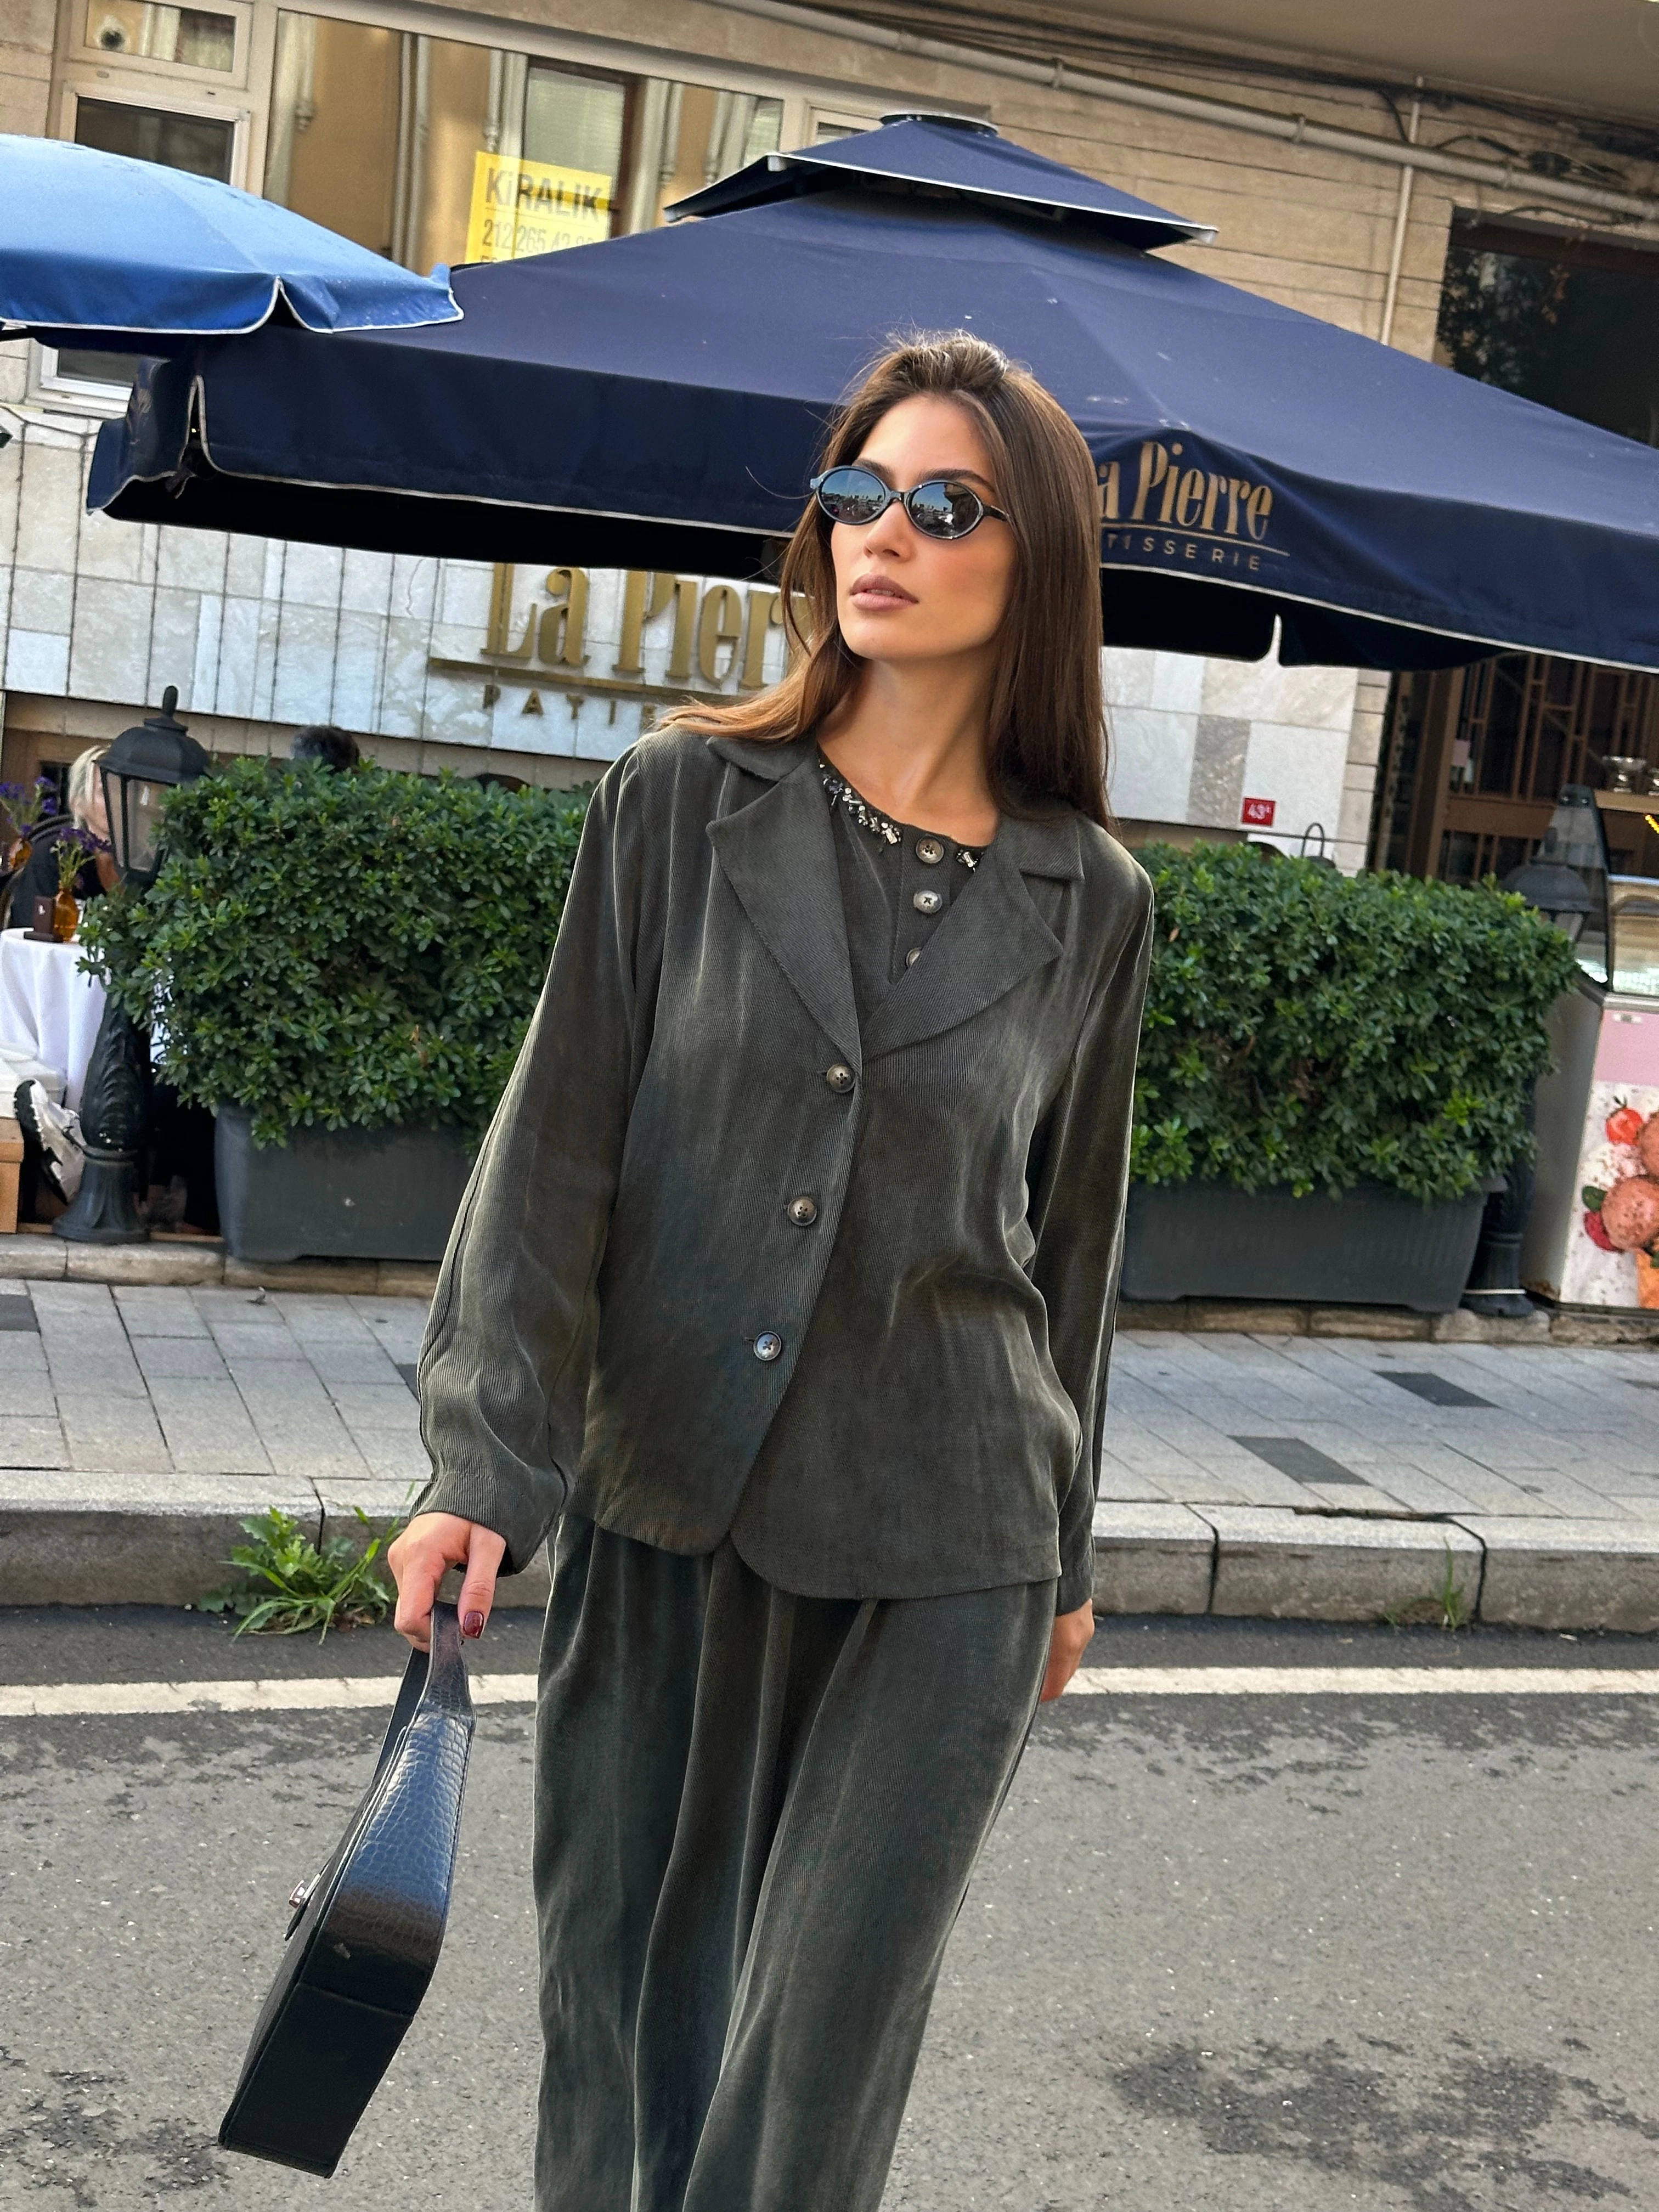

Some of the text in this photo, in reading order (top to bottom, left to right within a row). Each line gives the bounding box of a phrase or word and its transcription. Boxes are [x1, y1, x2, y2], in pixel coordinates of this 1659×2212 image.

[482, 219, 513, 249] 212
[515, 224, 547, 253] 265
[1097, 441, 1273, 541] a Pierre
[1107, 533, 1261, 571] TISSERIE
[480, 561, 591, 668] La
